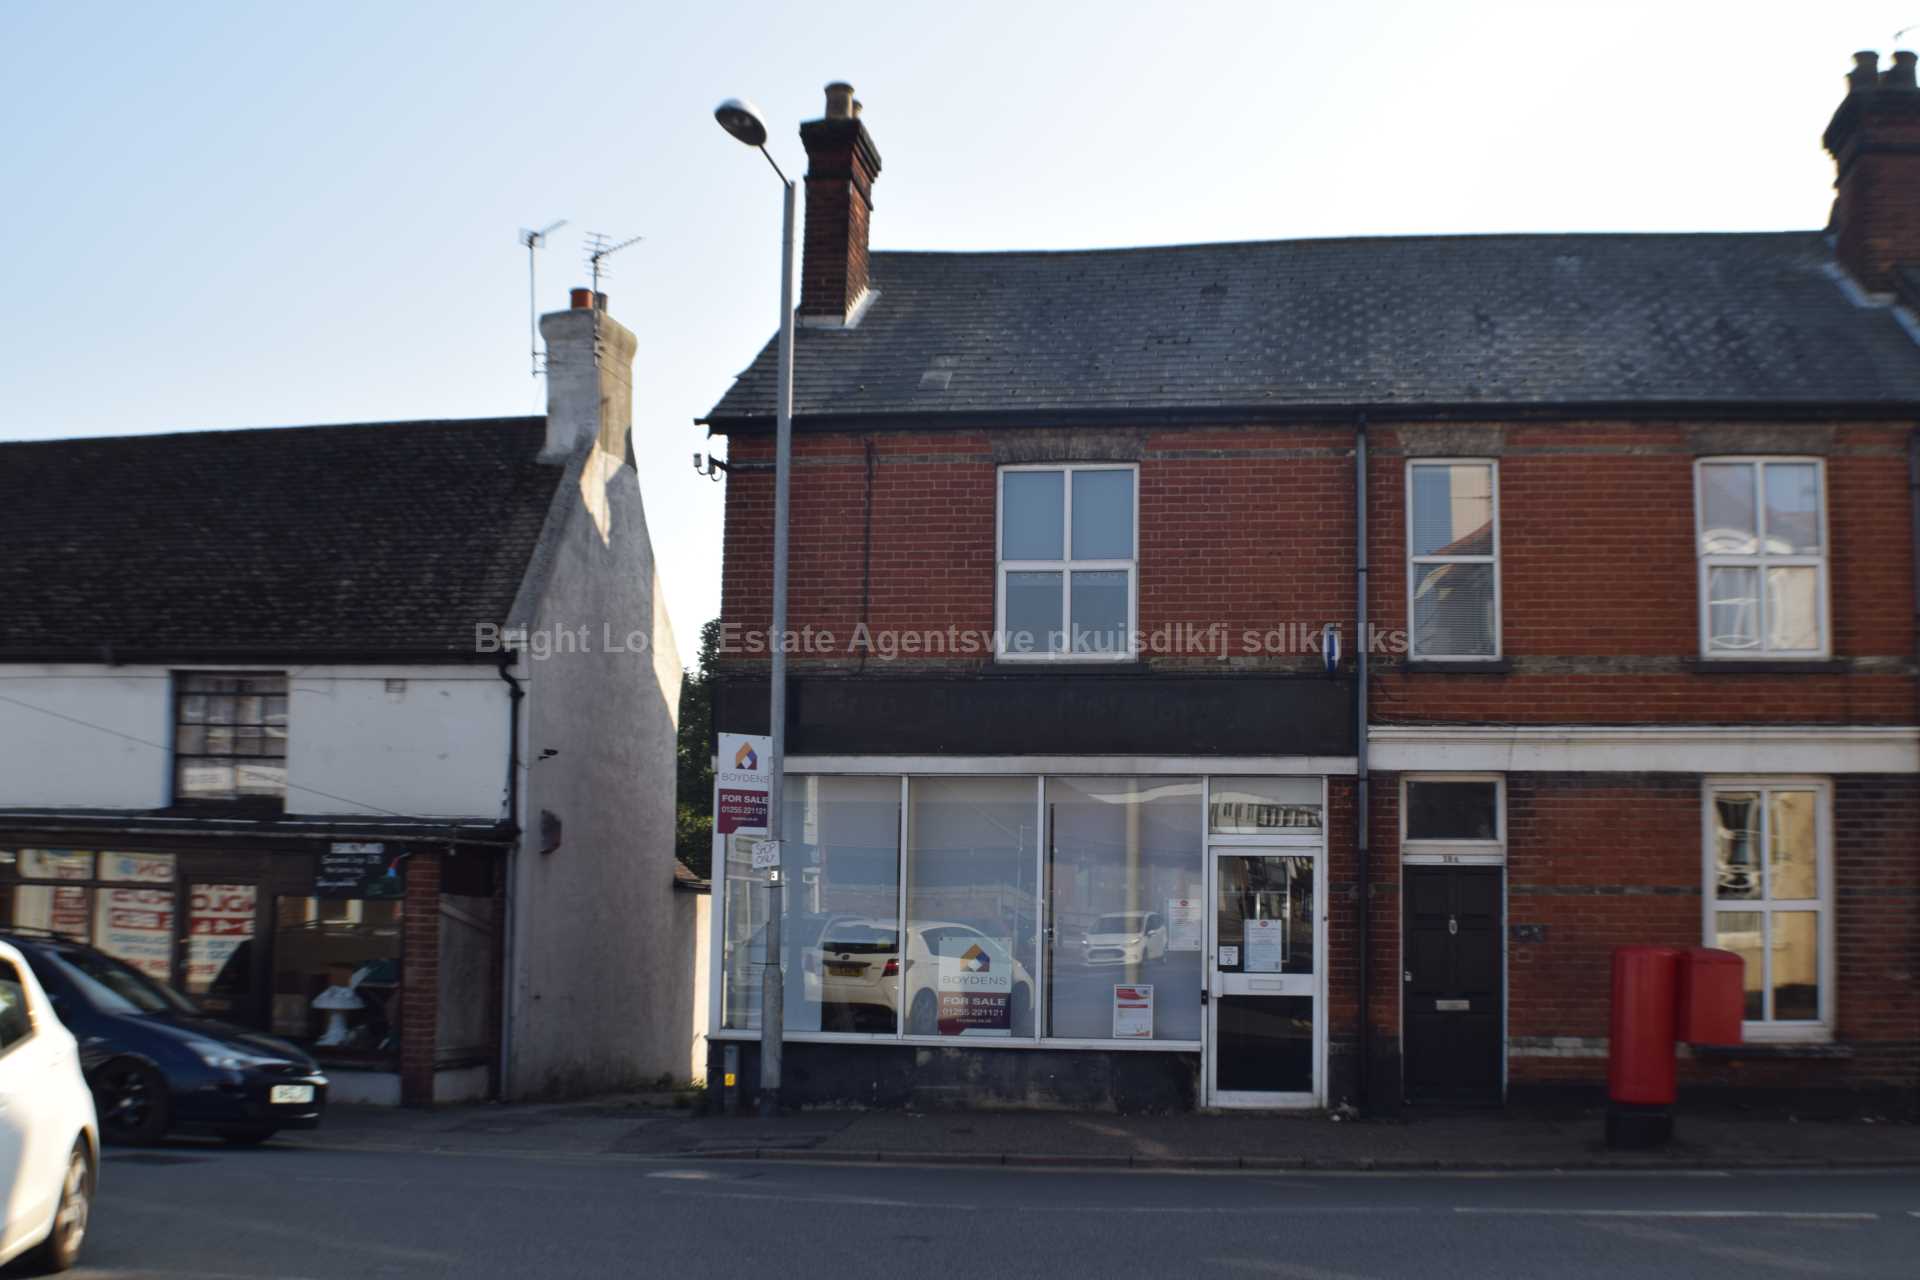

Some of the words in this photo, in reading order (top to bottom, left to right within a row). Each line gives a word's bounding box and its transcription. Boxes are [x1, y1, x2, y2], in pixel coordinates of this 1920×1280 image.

[722, 773, 768, 784] BOYDENS
[722, 795, 742, 803] FOR
[743, 795, 768, 804] SALE
[943, 976, 1007, 985] BOYDENS
[943, 997, 969, 1005] FOR
[972, 998, 1006, 1006] SALE
